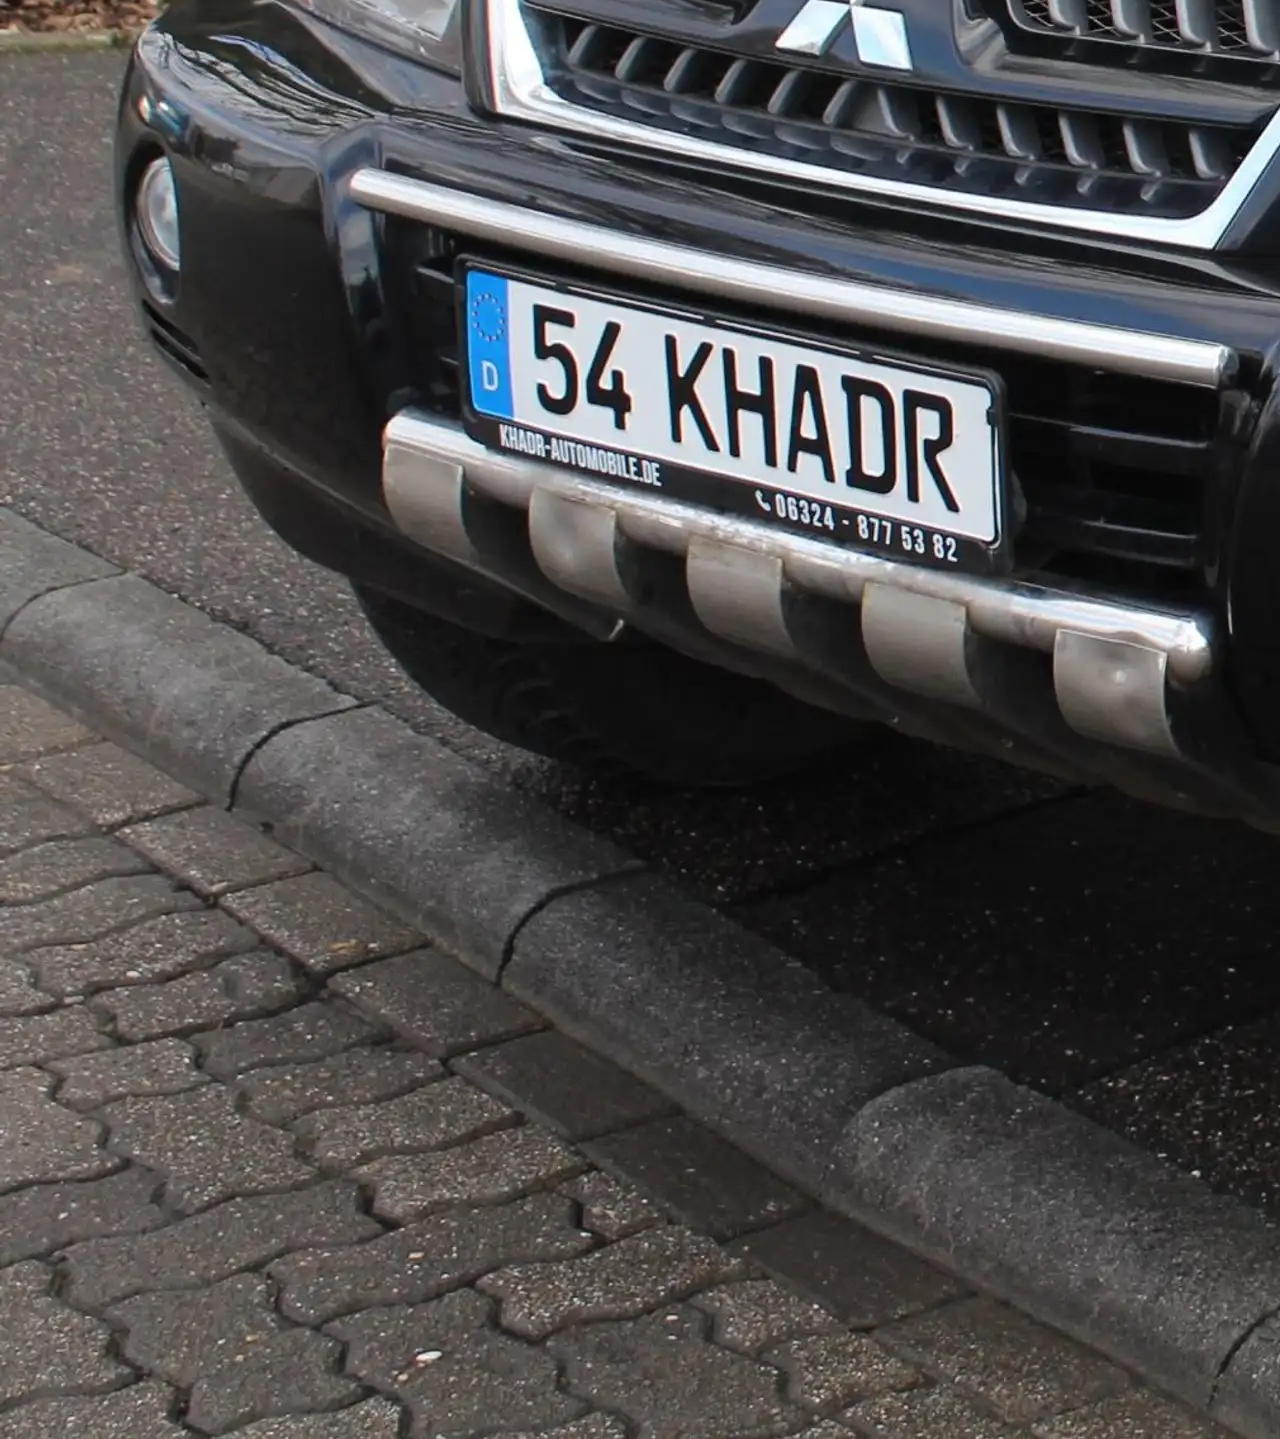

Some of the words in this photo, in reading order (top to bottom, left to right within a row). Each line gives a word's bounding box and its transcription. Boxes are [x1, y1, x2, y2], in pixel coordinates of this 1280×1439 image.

[481, 360, 499, 391] D
[533, 303, 632, 430] 54
[664, 334, 960, 513] KHADR
[499, 423, 662, 487] KHADR-AUTOMOBILE.DE
[775, 492, 835, 531] 06324
[857, 514, 892, 545] 877
[901, 526, 926, 555] 53
[932, 532, 959, 563] 82
